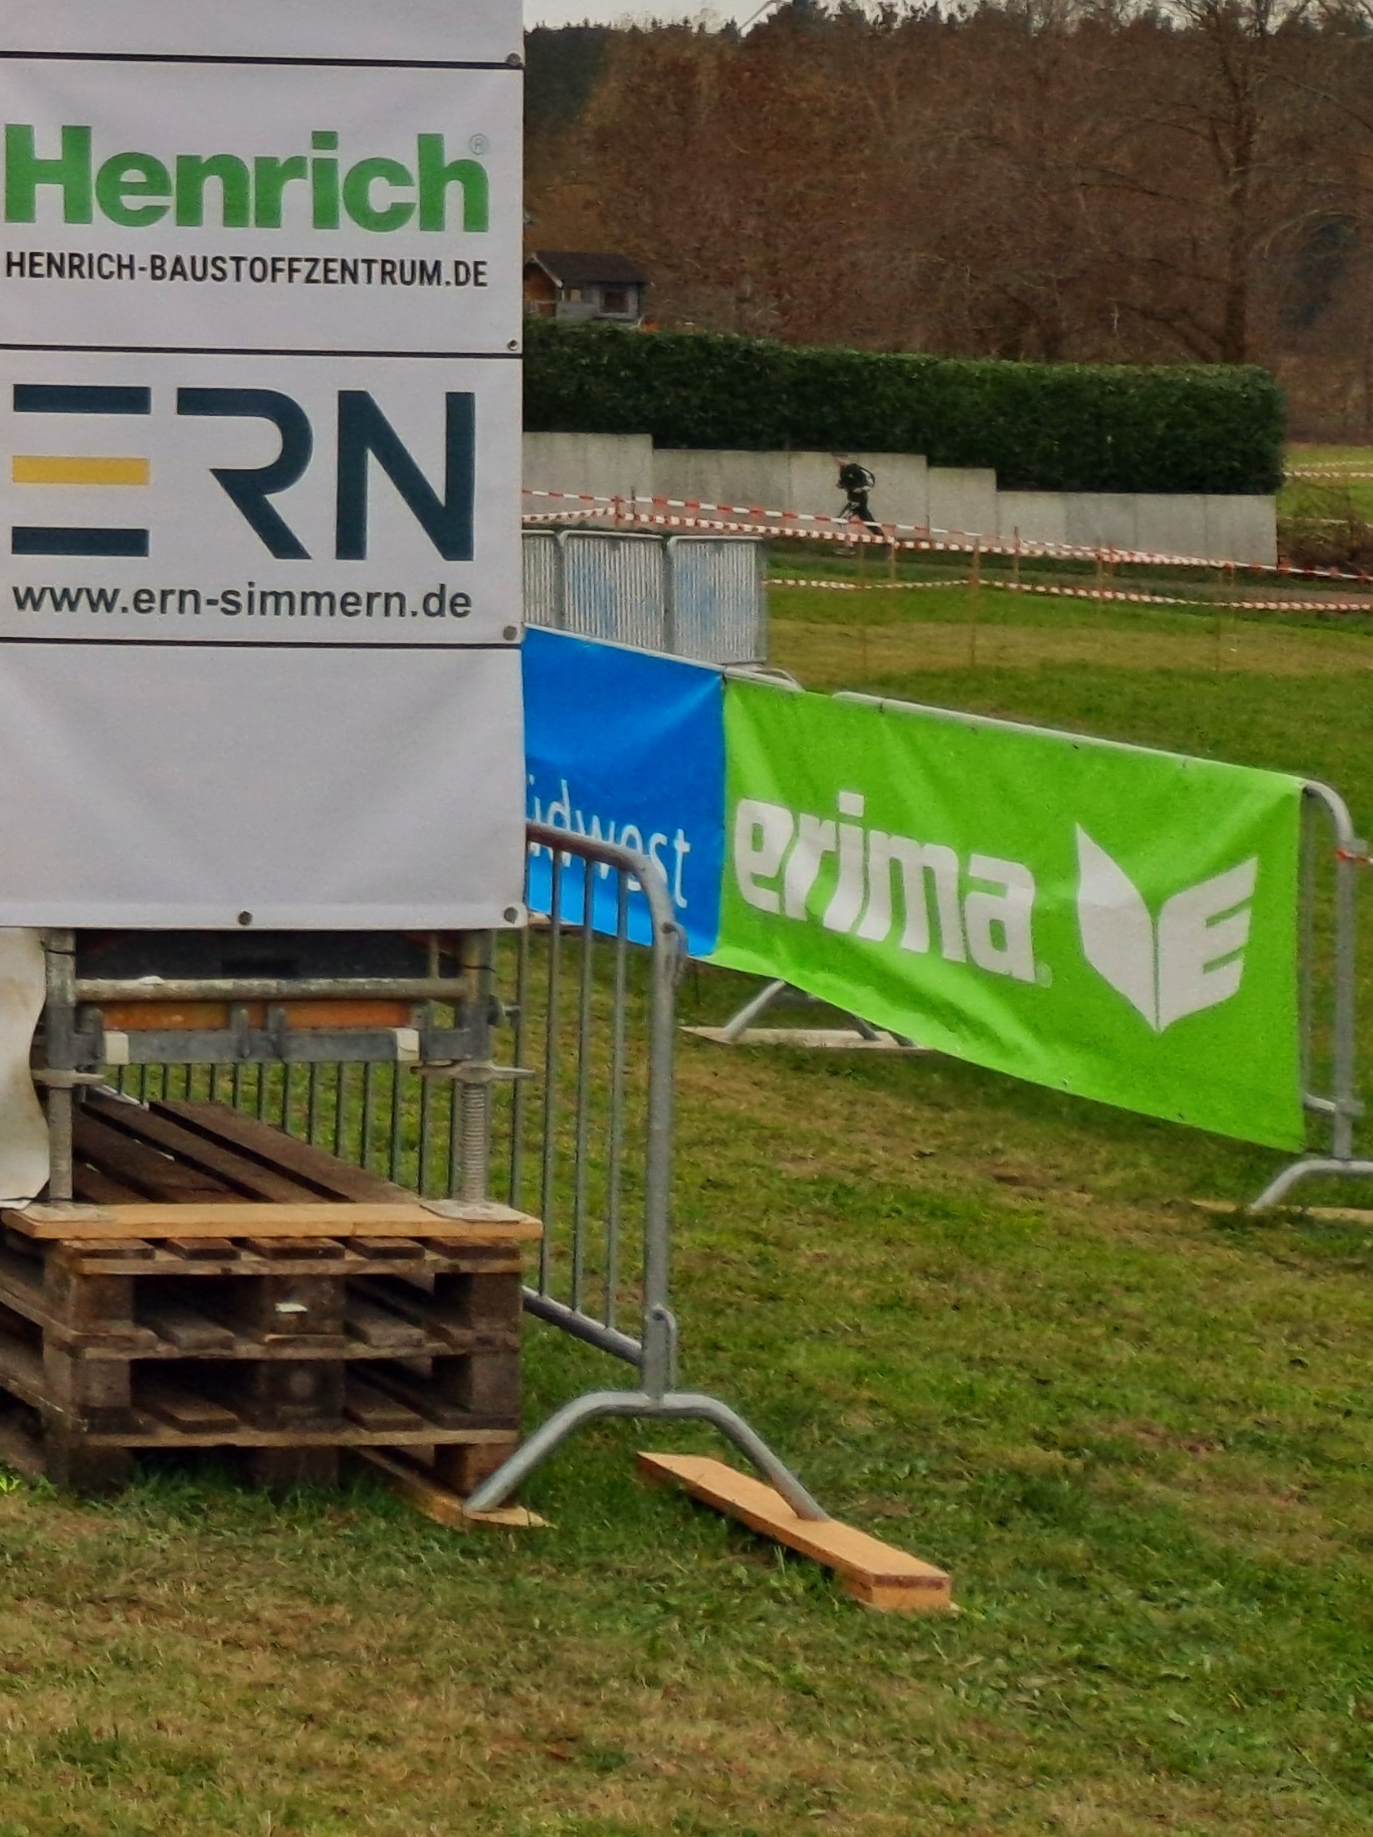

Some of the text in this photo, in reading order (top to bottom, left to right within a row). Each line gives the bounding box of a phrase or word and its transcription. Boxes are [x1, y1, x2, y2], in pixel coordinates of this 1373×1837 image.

[4, 123, 489, 233] Henrich
[5, 251, 489, 287] HENRICH-BAUSTOFFZENTRUM.DE
[11, 384, 476, 561] ERN
[12, 583, 472, 619] www.ern-simmern.de
[735, 791, 1036, 984] erima
